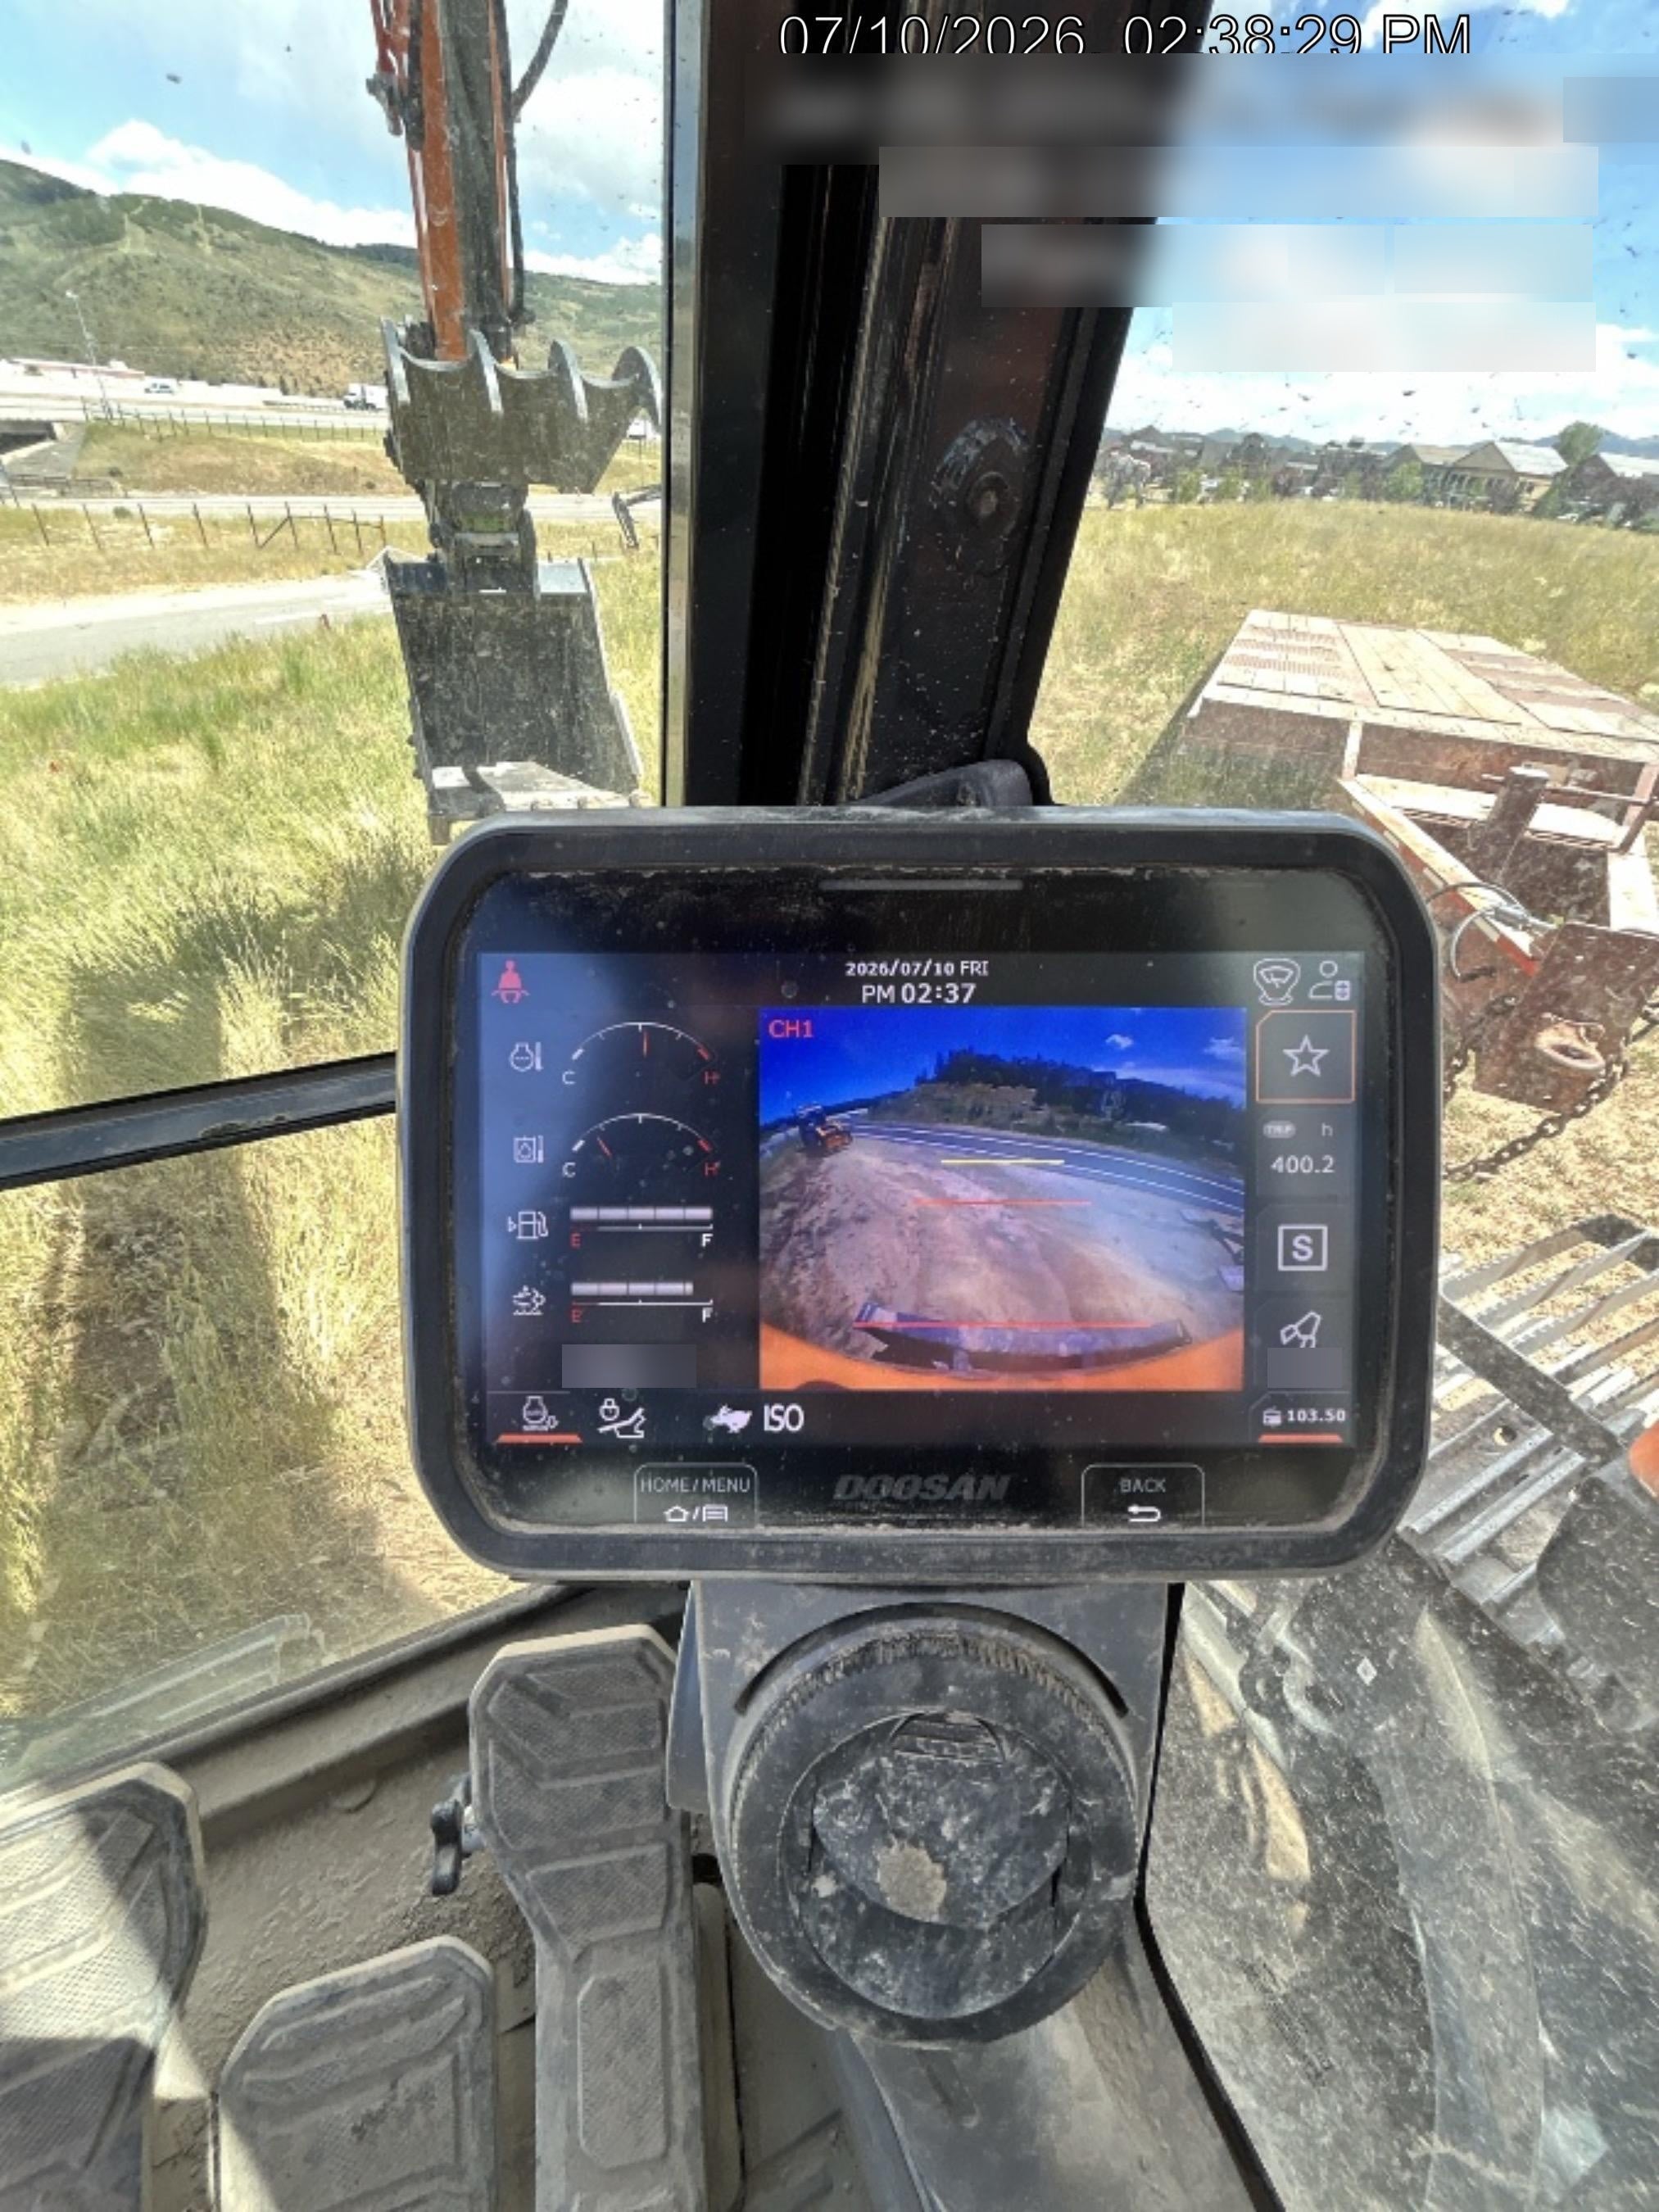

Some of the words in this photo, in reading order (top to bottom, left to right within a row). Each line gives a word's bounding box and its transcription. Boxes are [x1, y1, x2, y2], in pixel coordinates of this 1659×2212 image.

[845, 959, 955, 977] 2026/07/10
[960, 960, 989, 976] FRI
[861, 985, 895, 1004] PM
[900, 983, 977, 1004] 02:37
[768, 1020, 814, 1039] CH1
[562, 1070, 575, 1085] C
[704, 1071, 718, 1085] H
[1321, 1122, 1333, 1137] h
[562, 1163, 576, 1177] C
[704, 1163, 718, 1176] H
[1271, 1154, 1335, 1173] 400.2
[570, 1233, 581, 1248] E
[701, 1234, 714, 1248] F
[1291, 1234, 1313, 1262] S
[571, 1308, 582, 1322] E
[701, 1308, 713, 1322] F
[763, 1404, 805, 1433] ISO
[1286, 1409, 1347, 1423] 103.50
[832, 1474, 1011, 1500] DOOSAN
[1118, 1478, 1167, 1494] BACK
